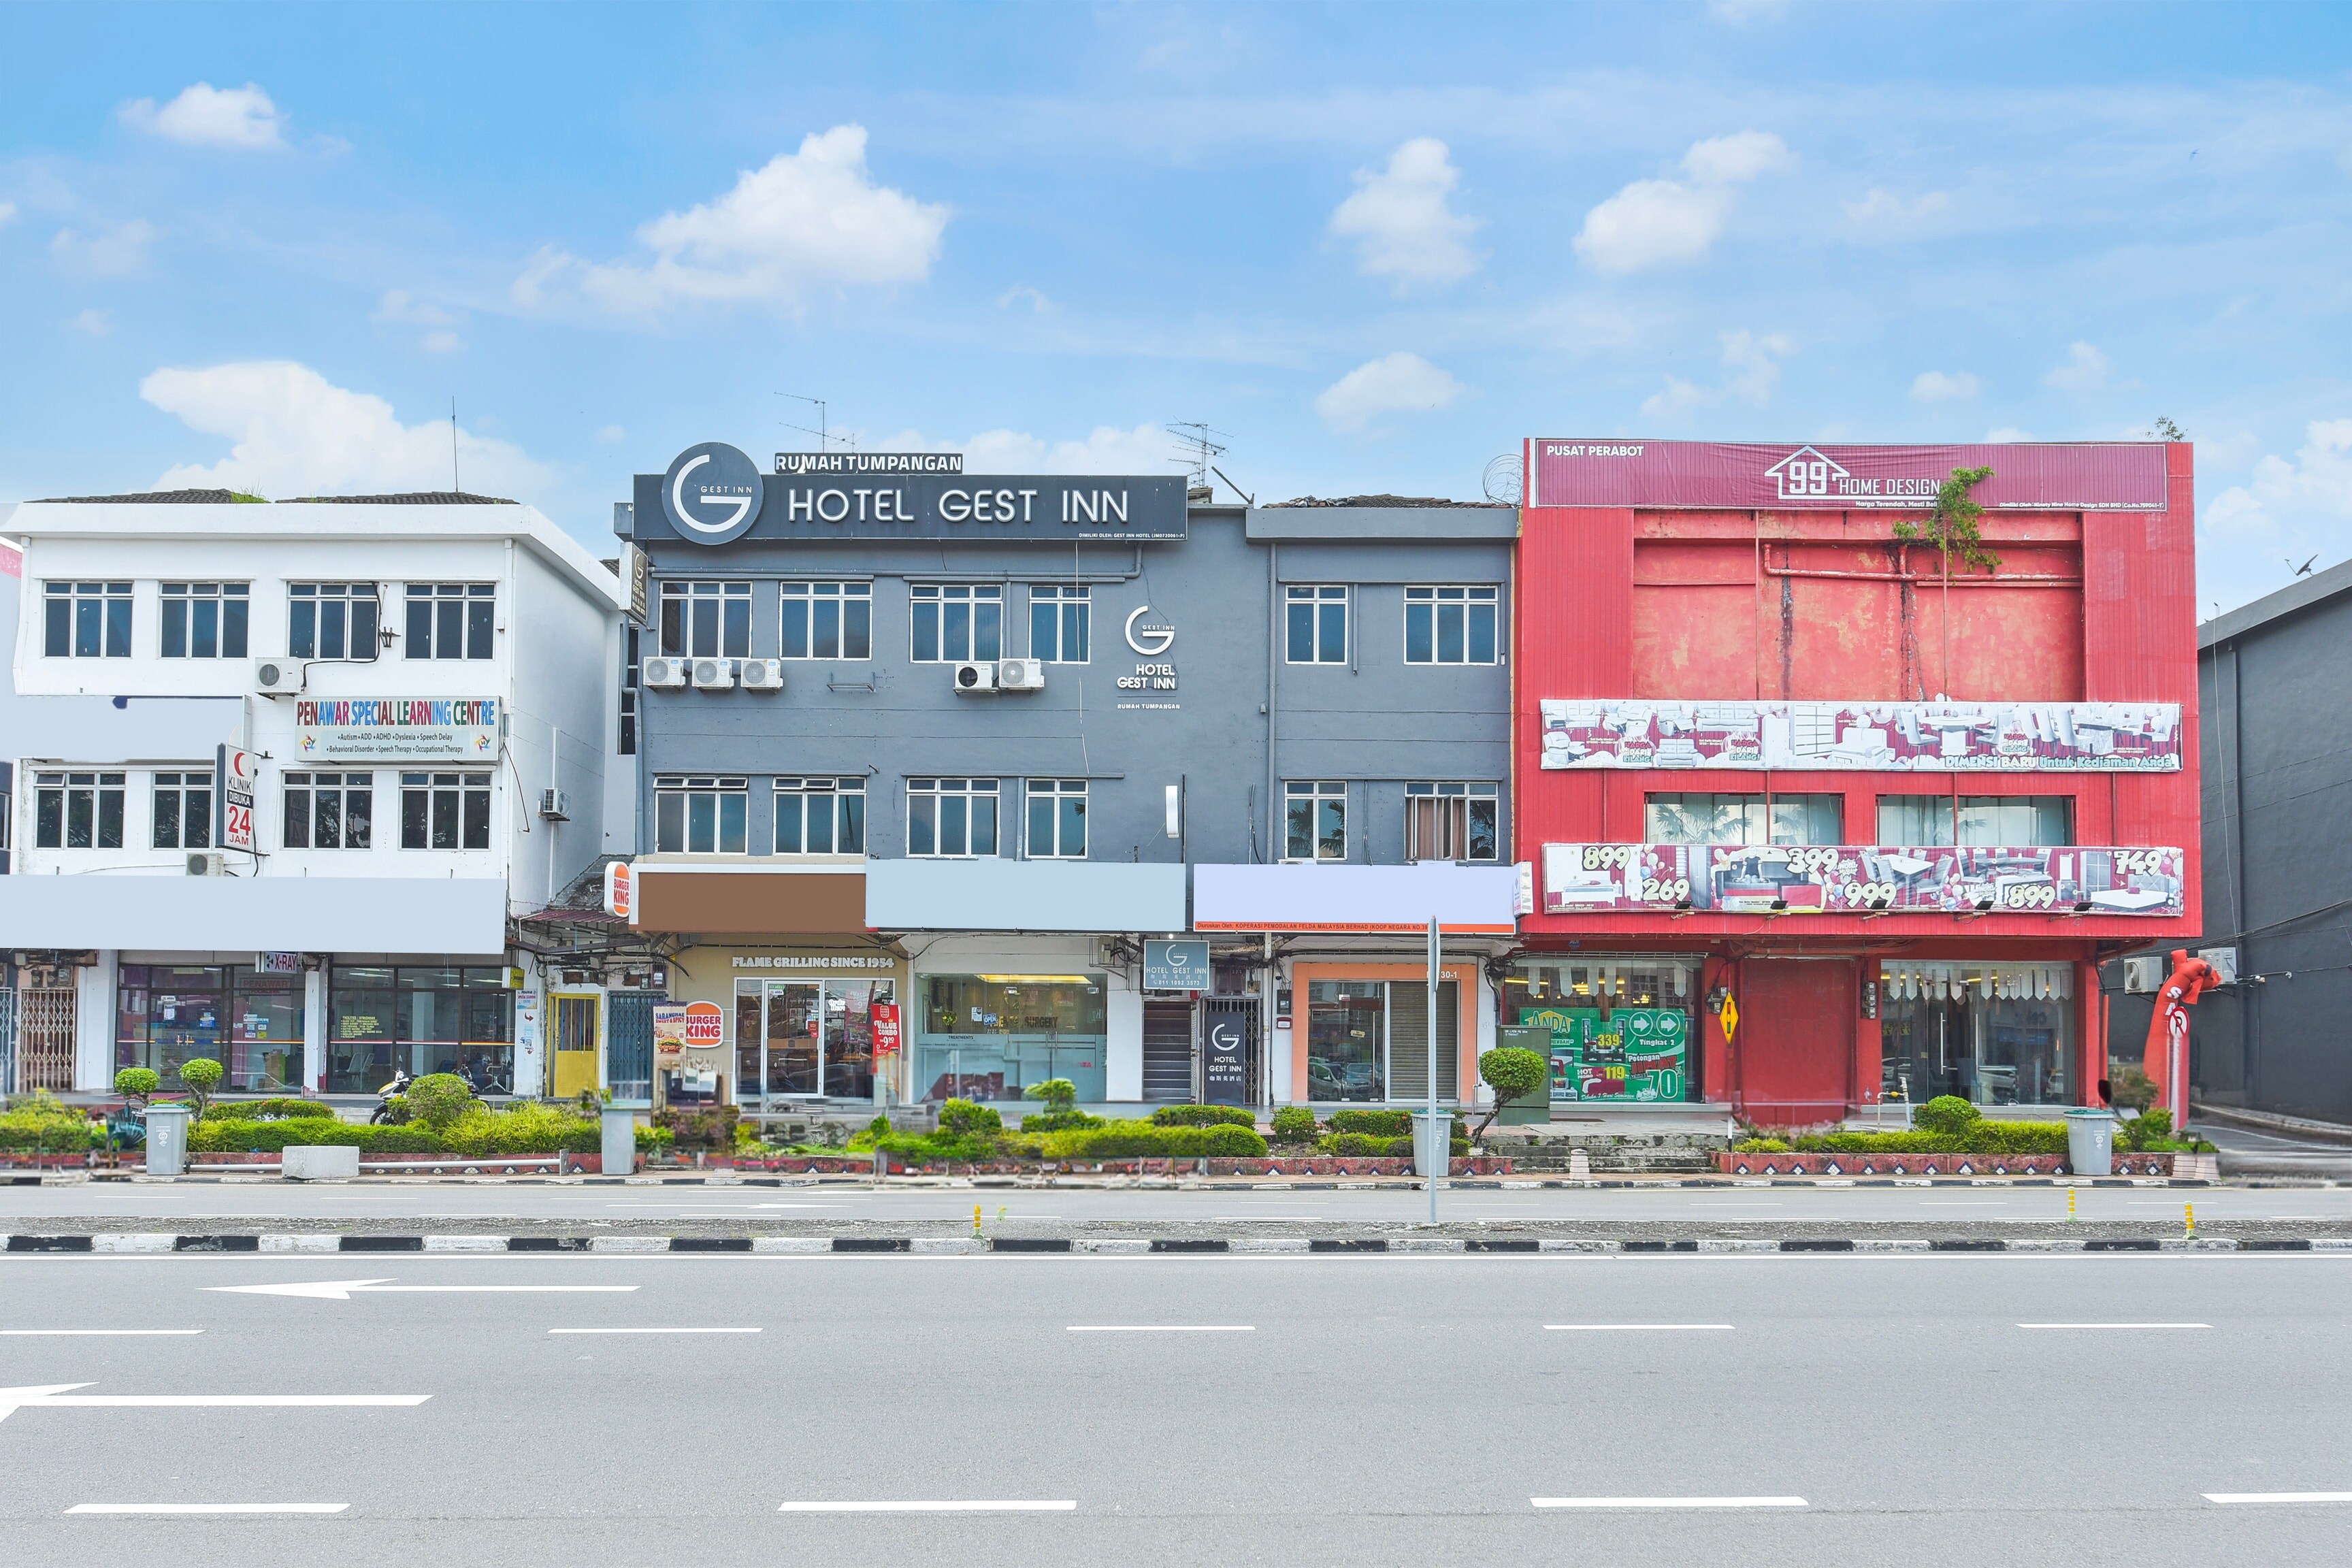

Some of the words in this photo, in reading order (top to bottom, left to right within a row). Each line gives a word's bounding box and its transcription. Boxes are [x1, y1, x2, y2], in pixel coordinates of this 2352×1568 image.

[1547, 446, 1585, 456] PUSAT
[1588, 446, 1644, 456] PERABOT
[776, 455, 841, 471] RUMAH
[846, 455, 962, 471] TUMPANGAN
[1789, 461, 1827, 494] 99
[1840, 478, 1880, 495] HOME
[1886, 478, 1940, 495] DESIGN
[789, 488, 915, 523] HOTEL
[938, 489, 1039, 523] GEST
[1062, 489, 1128, 523] INN
[1136, 664, 1175, 676] HOTEL
[1117, 676, 1148, 689] GEST
[1154, 678, 1175, 689] INN
[297, 701, 350, 726] PENAWAR
[351, 701, 395, 726] SPECIAL
[397, 701, 451, 726] LEARNING
[453, 700, 495, 726] CENTRE
[420, 733, 438, 741] Speech
[439, 733, 453, 742] Delay
[394, 745, 412, 753] Therapy
[445, 746, 463, 754] Therapy
[1945, 755, 1998, 768] DIMENSI
[2001, 755, 2037, 768] BARU
[2038, 755, 2075, 768] Untuk
[2076, 755, 2136, 768] Kediaman
[228, 775, 251, 794] KLINIK
[229, 791, 250, 806] DIBUKA
[228, 805, 251, 836] 24
[229, 834, 249, 846] JAM
[1582, 845, 1631, 871] 899
[1784, 847, 1839, 875] 399
[2113, 849, 2162, 876] 749
[614, 878, 630, 892] BURGER
[1642, 877, 1690, 902] 269
[614, 889, 630, 906] KING
[1844, 881, 1897, 909] 999
[2008, 884, 2056, 909] 899
[732, 957, 772, 968] FLAME
[773, 957, 830, 968] GRILLING
[830, 957, 866, 968] SINCE
[867, 957, 894, 968] 1954
[686, 1016, 721, 1024] BURGER
[874, 1020, 897, 1030] VALUE
[1024, 1016, 1058, 1028] SURGERY
[1531, 1011, 1571, 1034] ANDA
[686, 1025, 721, 1037] KING
[1597, 1034, 1620, 1046] 339
[1628, 1054, 1660, 1062] Potongan
[1604, 1066, 1625, 1079] 119
[1631, 1056, 1677, 1075] JIMAT
